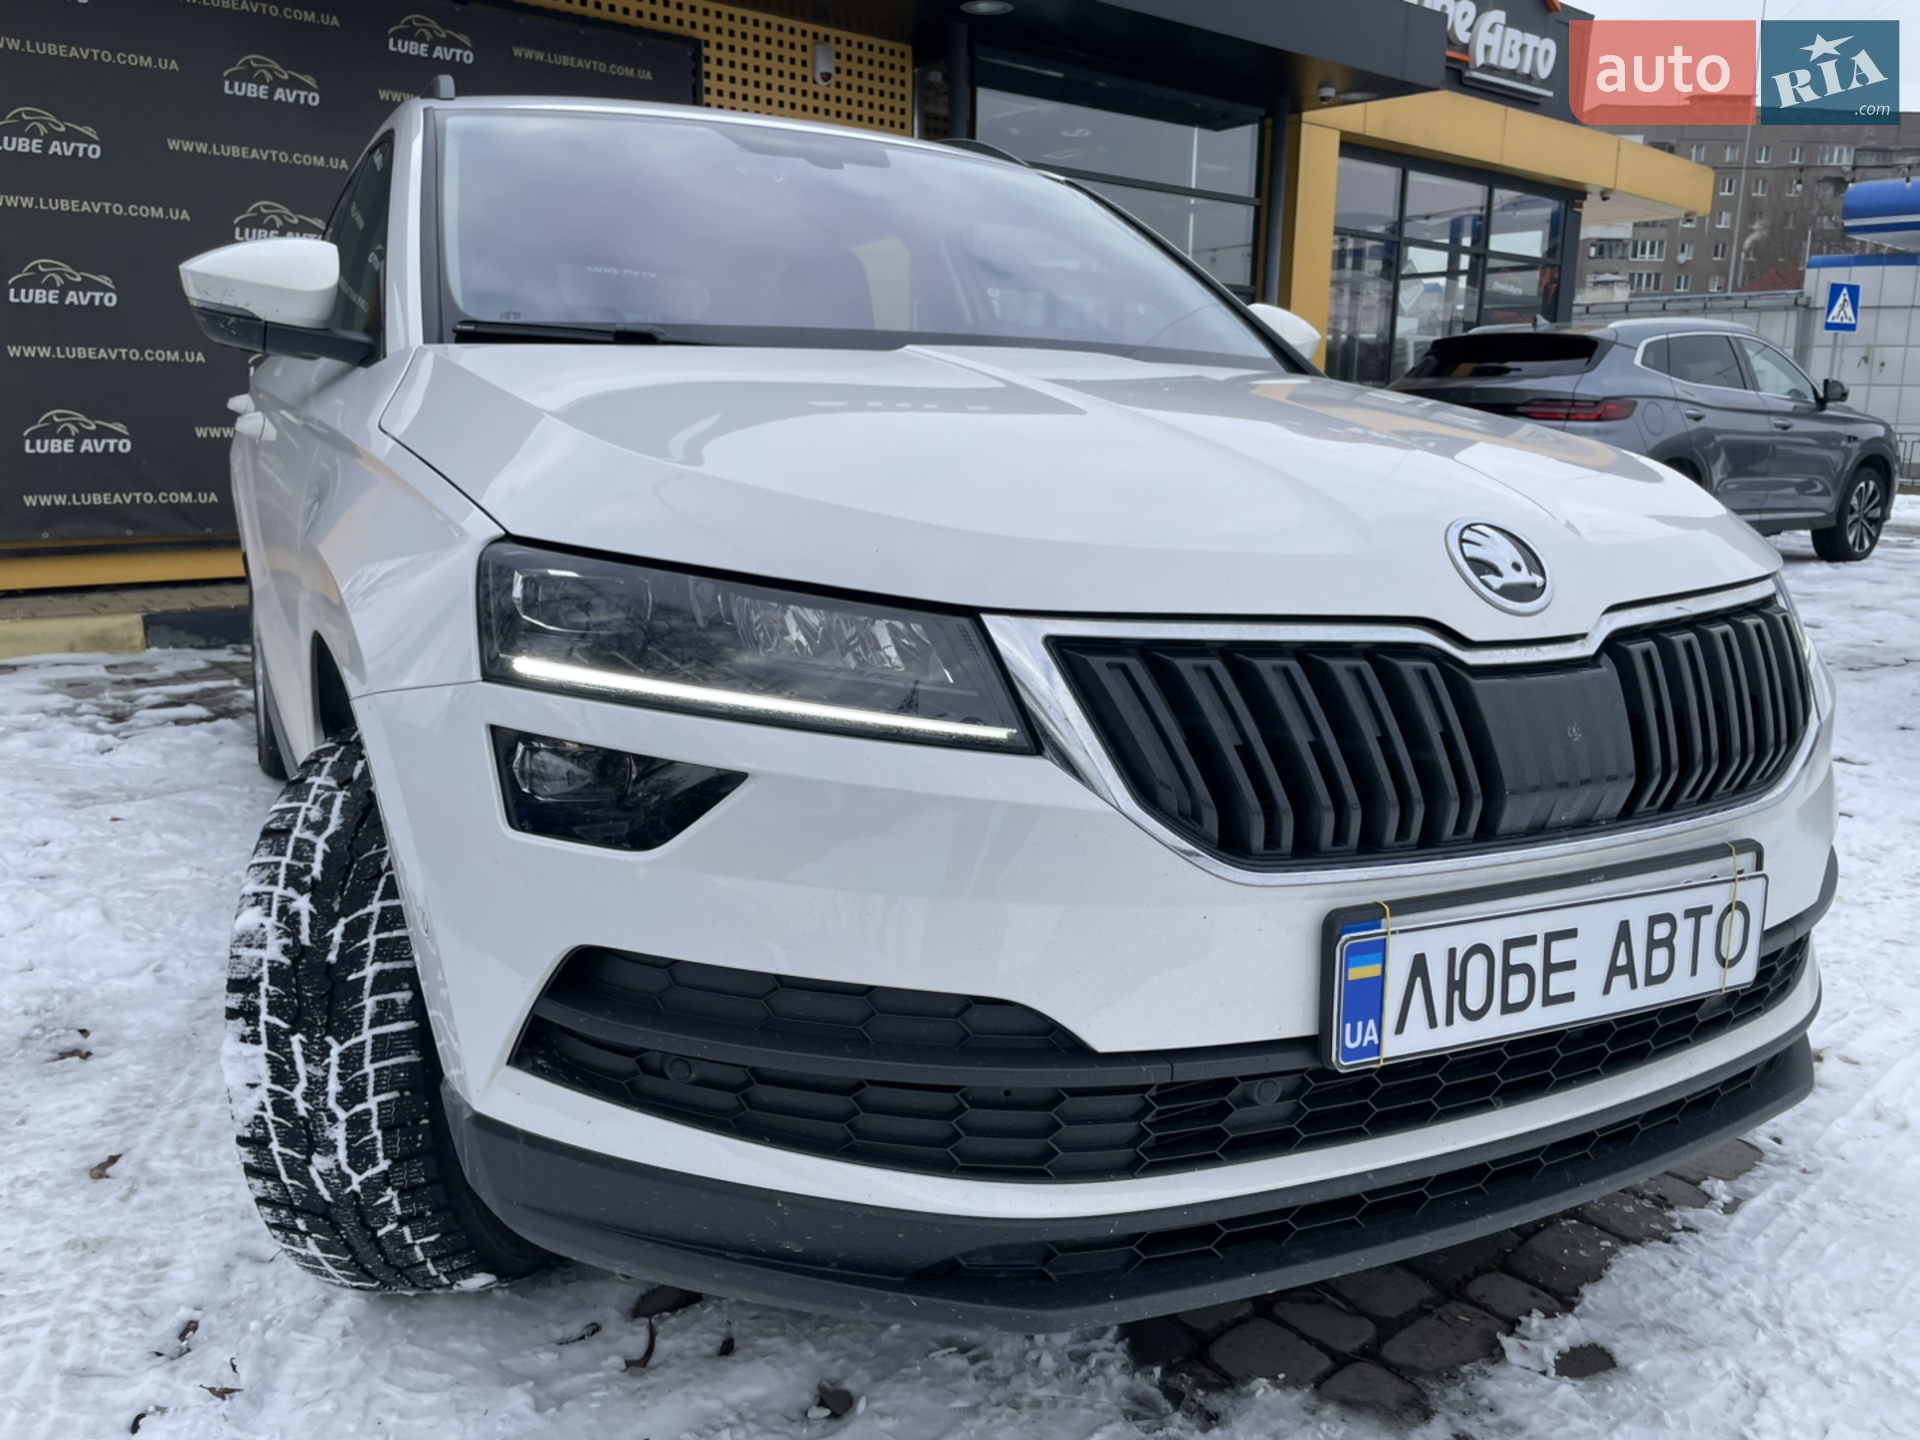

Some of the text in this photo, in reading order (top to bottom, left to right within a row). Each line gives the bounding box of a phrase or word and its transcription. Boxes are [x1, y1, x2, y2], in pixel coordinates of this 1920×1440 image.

[388, 38, 474, 64] LUBE AVTO
[512, 46, 653, 81] WWW.LUBEAVTO.COM.UA
[224, 80, 320, 107] LUBE AVTO
[0, 136, 101, 160] UBE AVTO
[167, 138, 349, 170] WWW.LUBEAVTO.COM.UA
[0, 194, 190, 221] WW.LUBEAVTO.COM.UA
[9, 288, 118, 307] LUBE AVTO
[7, 345, 206, 364] WWW.LUBEAVTO.COM.UA
[24, 438, 132, 454] LUBE AVTO
[23, 492, 219, 507] WWW.LUBEAVTO.COM.UA
[1394, 899, 1751, 1036] ЛЮБЕ АВТО
[1344, 1018, 1379, 1049] UA
